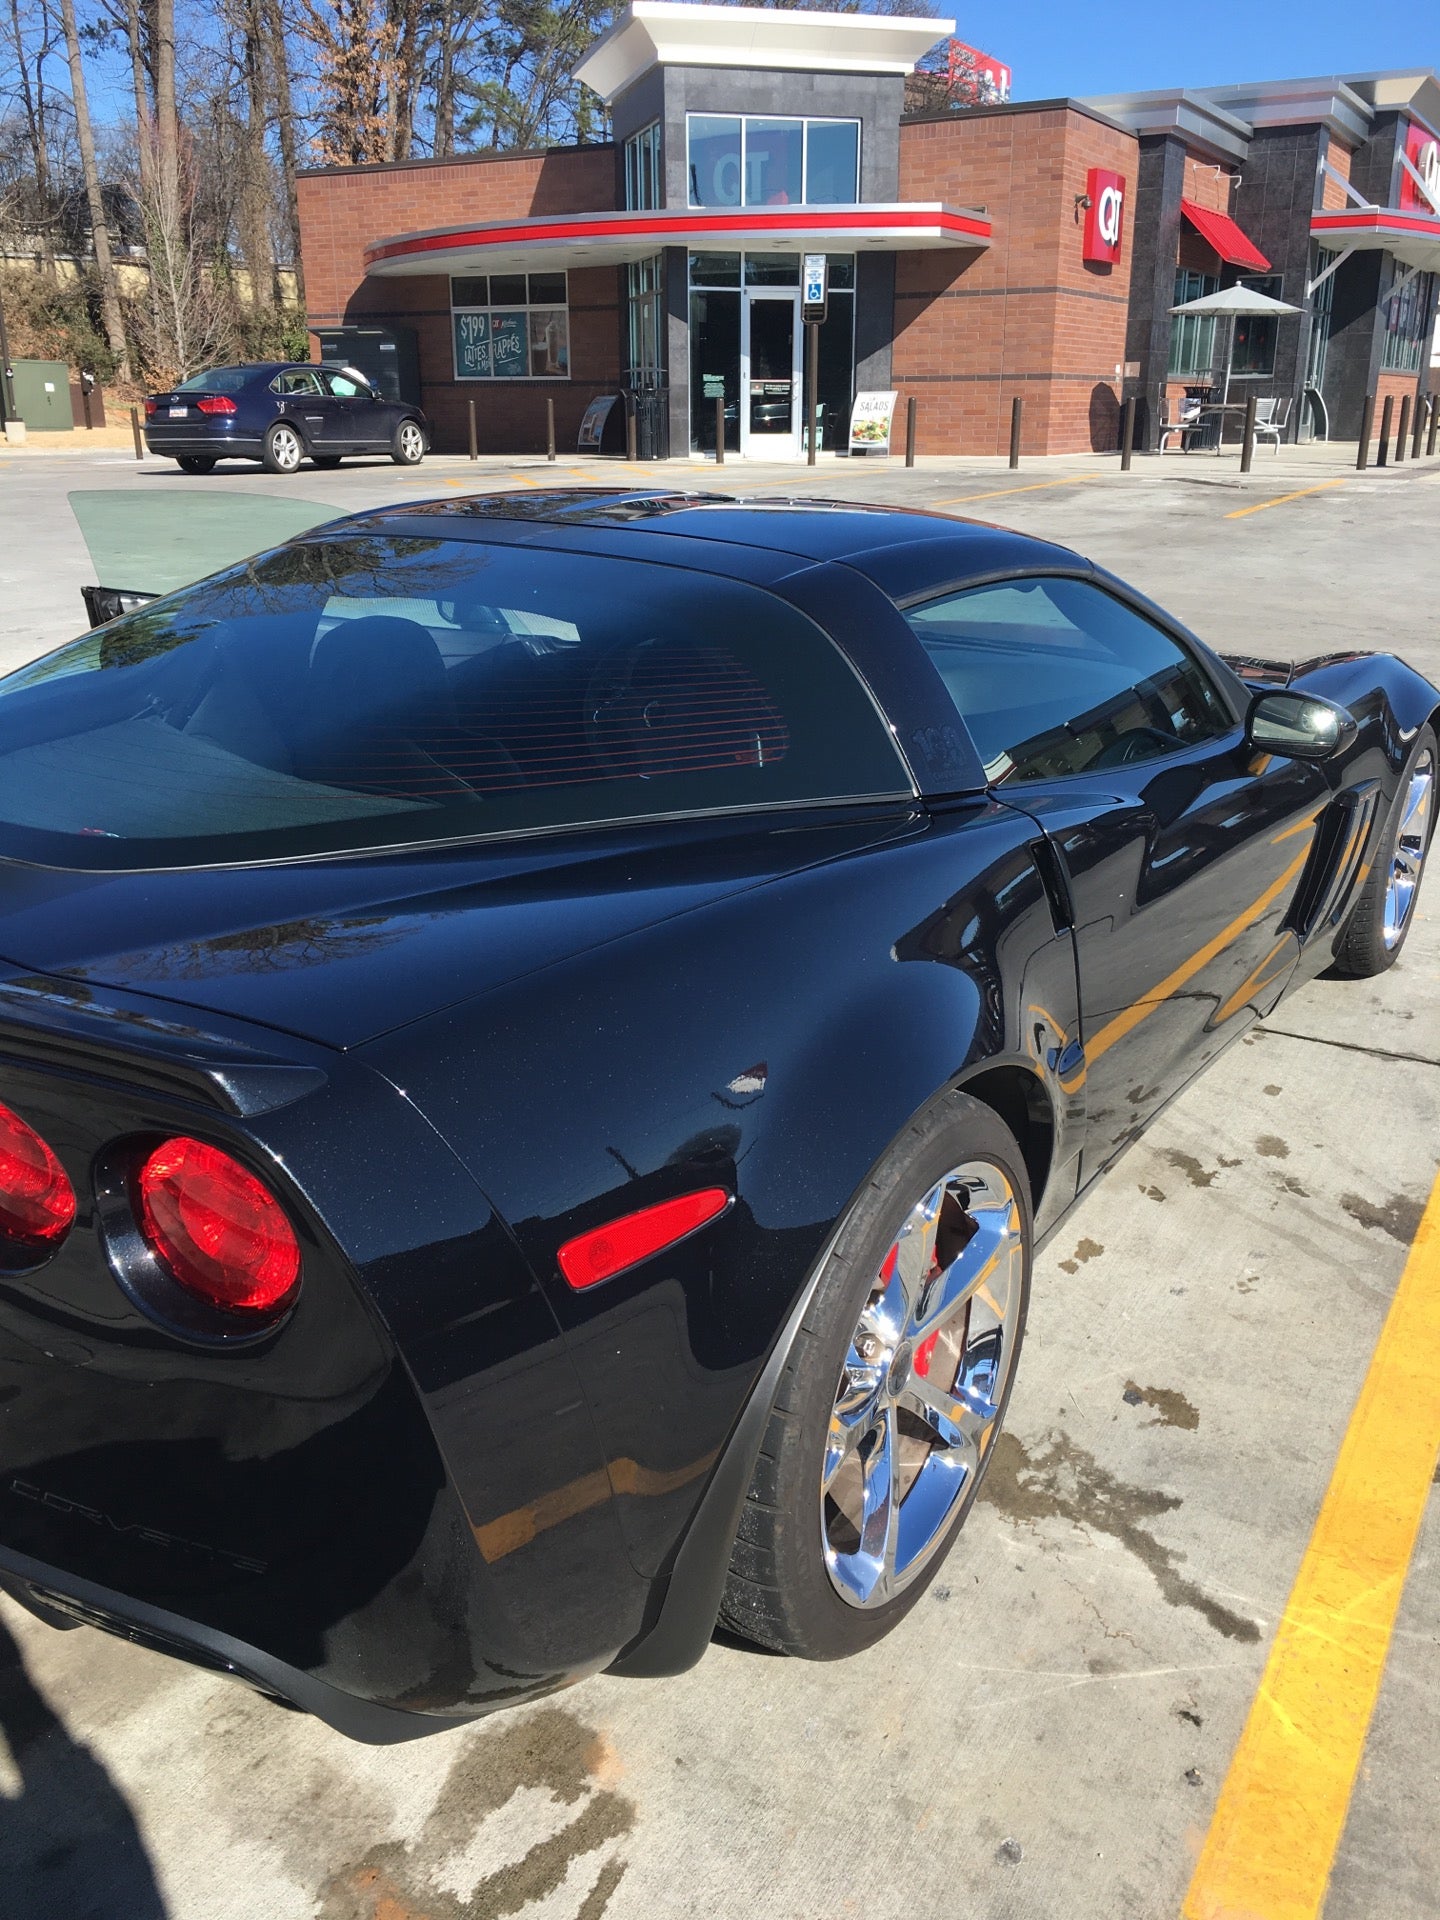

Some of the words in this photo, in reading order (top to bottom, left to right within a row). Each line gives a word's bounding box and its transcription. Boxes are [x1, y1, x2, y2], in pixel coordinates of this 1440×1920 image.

[713, 151, 770, 205] QT
[1099, 186, 1123, 246] QT
[464, 345, 488, 367] LATTES,
[859, 400, 890, 413] SALADS
